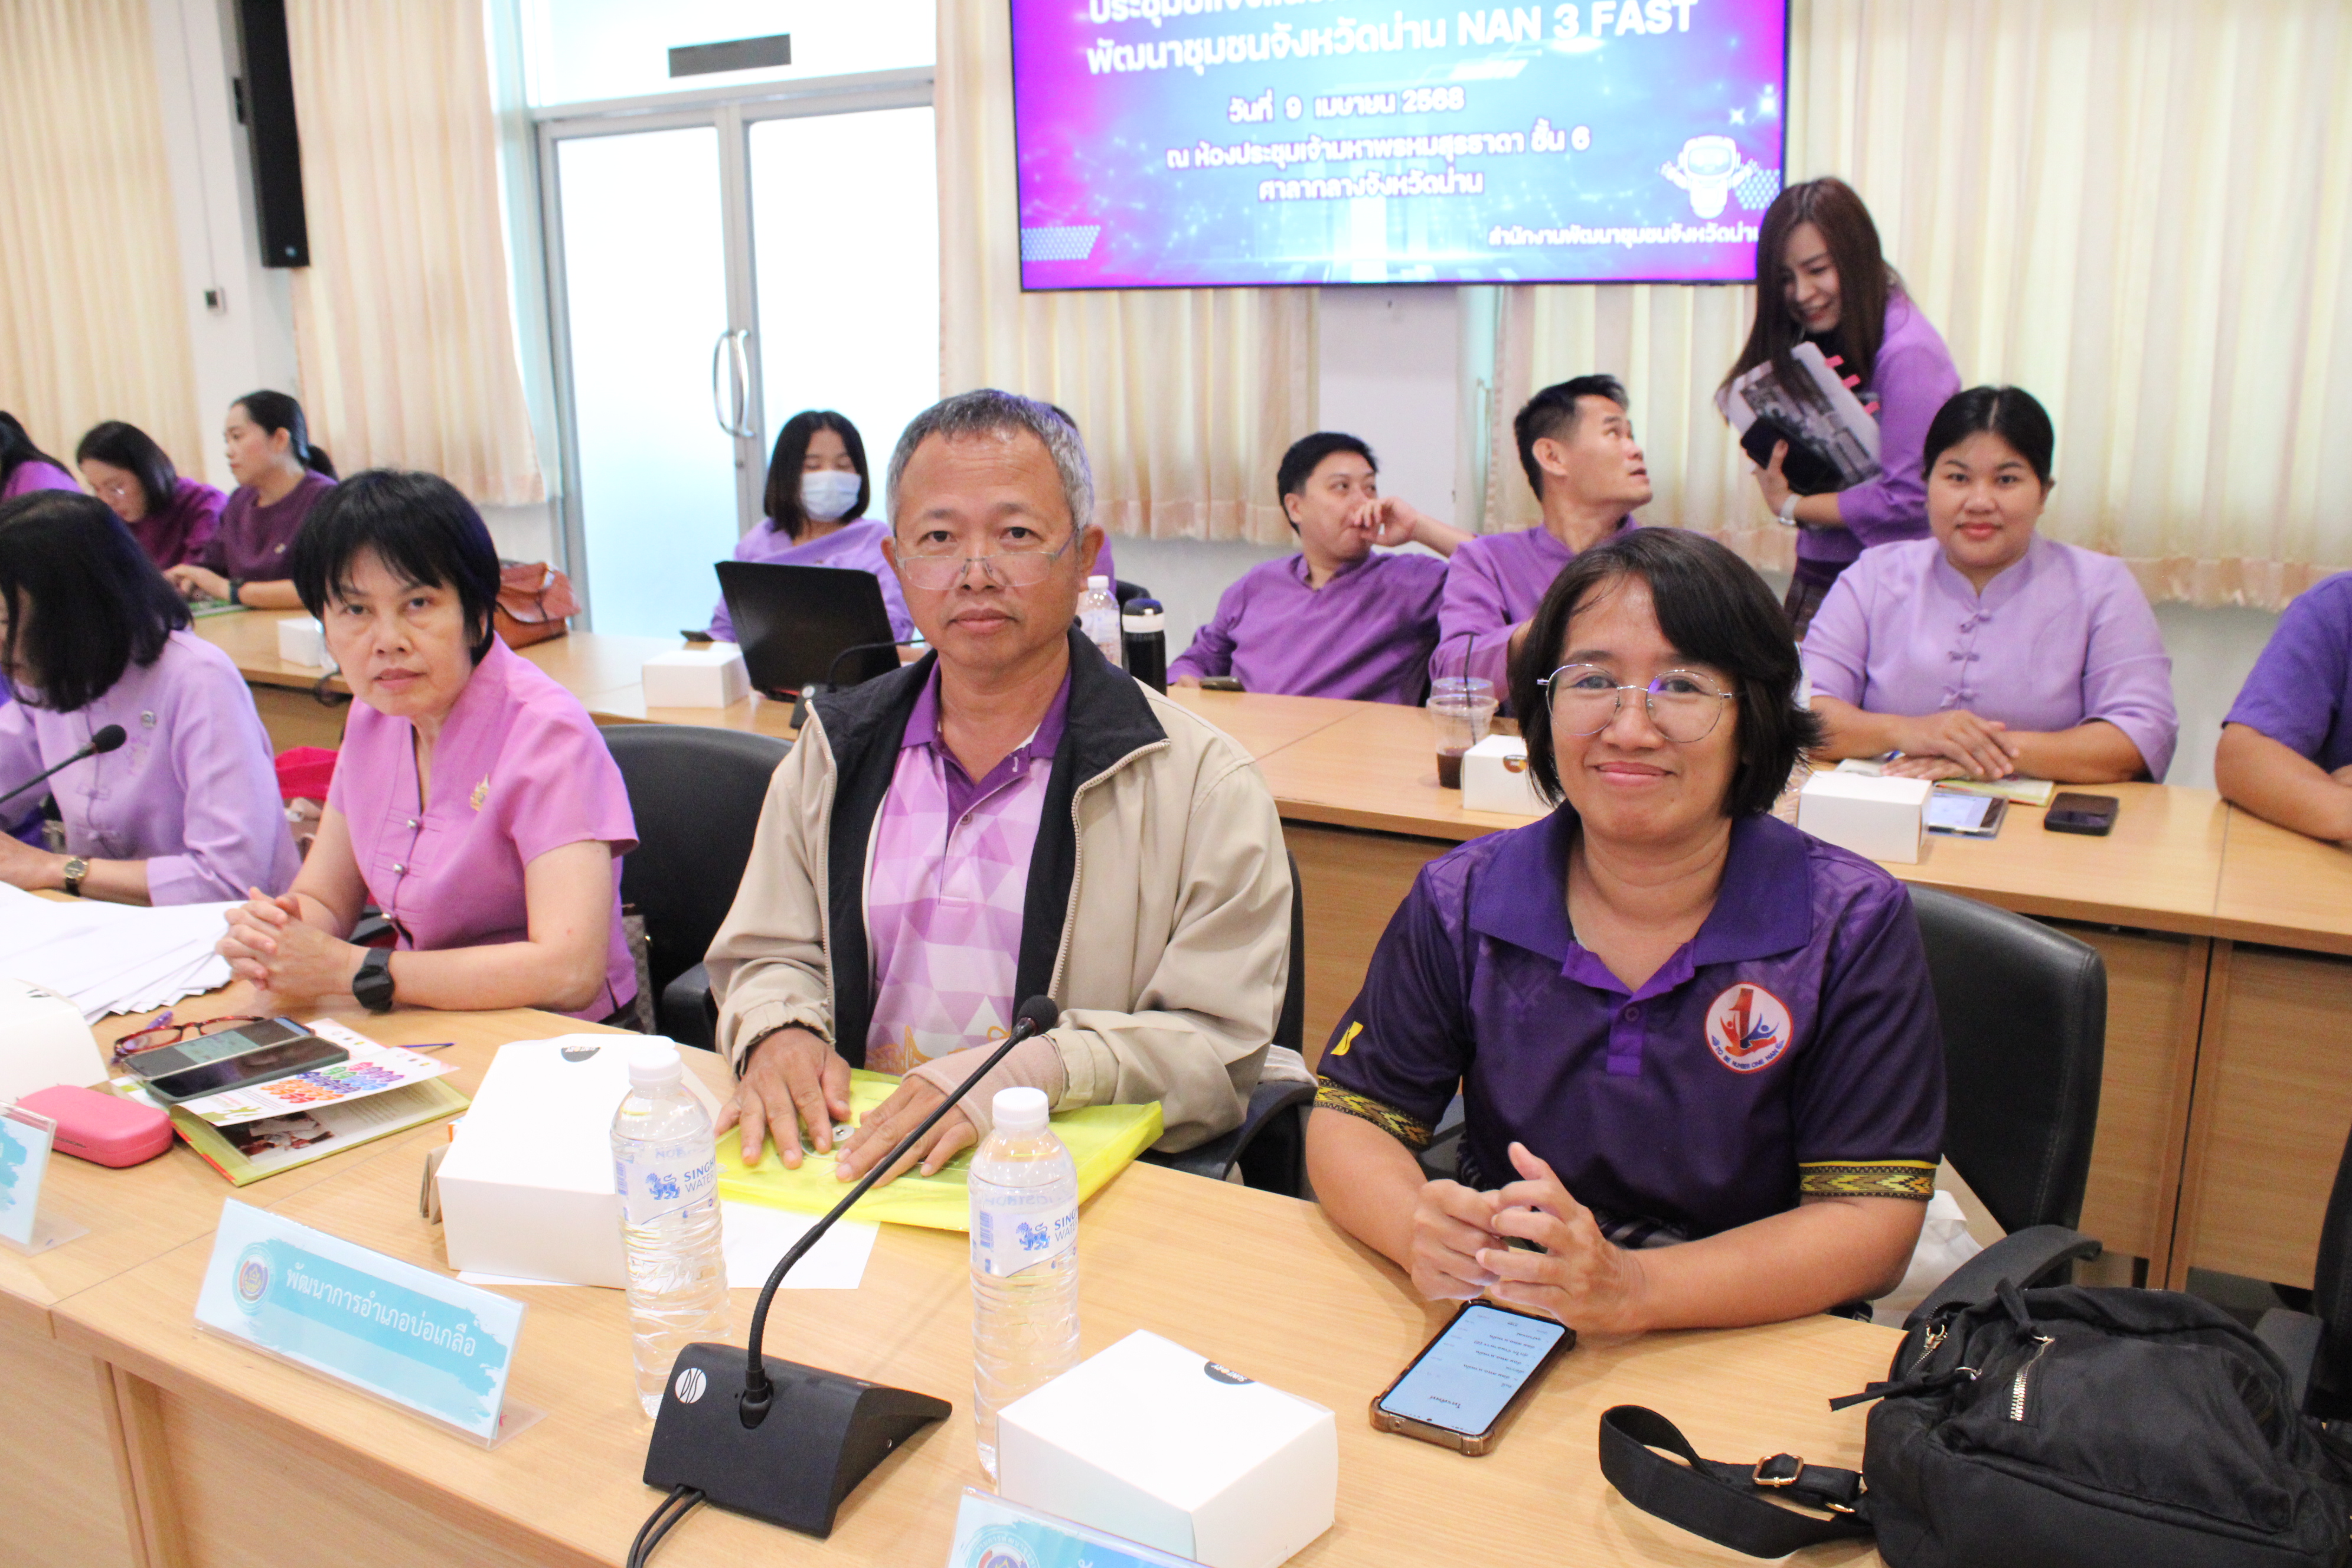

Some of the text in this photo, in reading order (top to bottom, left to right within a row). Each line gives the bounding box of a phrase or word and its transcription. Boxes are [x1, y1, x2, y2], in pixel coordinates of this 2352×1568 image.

[1087, 10, 1446, 76] พัฒนาชุมชนจังหวัดน่าน
[1458, 5, 1541, 46] NAN
[1553, 3, 1579, 39] 3
[1592, 0, 1699, 37] FAST
[1229, 86, 1465, 122] วันที่ 9 เมษายน 2568
[1166, 148, 1190, 168] ณ
[1531, 117, 1566, 152] ชั้น
[1571, 125, 1591, 151] 6
[1259, 166, 1483, 201] ศาลากลางจังหวัดน่าน
[286, 1261, 477, 1358] พัฒนาการอำเภอบ่อเกลือ
